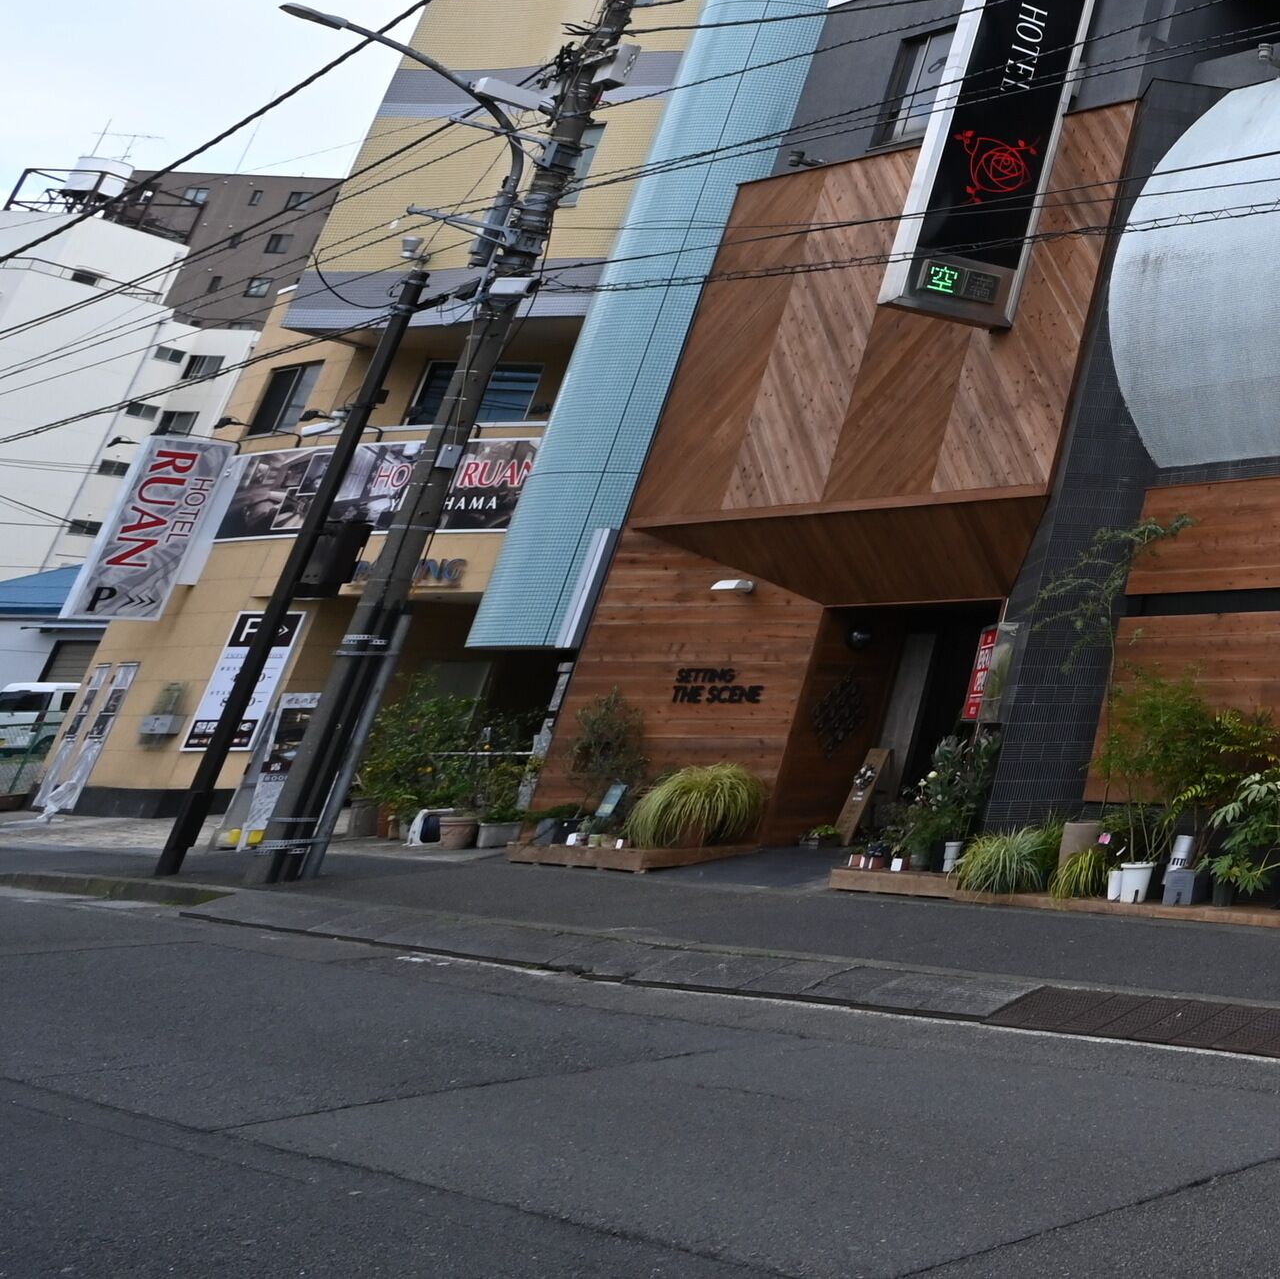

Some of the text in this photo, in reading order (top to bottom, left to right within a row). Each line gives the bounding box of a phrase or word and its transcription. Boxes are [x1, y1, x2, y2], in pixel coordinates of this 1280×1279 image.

[1000, 2, 1048, 91] HOTEL
[927, 266, 958, 293] 空
[105, 450, 198, 567] RUAN
[165, 478, 213, 543] HOTEL
[86, 586, 117, 612] P
[676, 668, 736, 683] SETTING
[672, 685, 764, 703] THE SCENE
